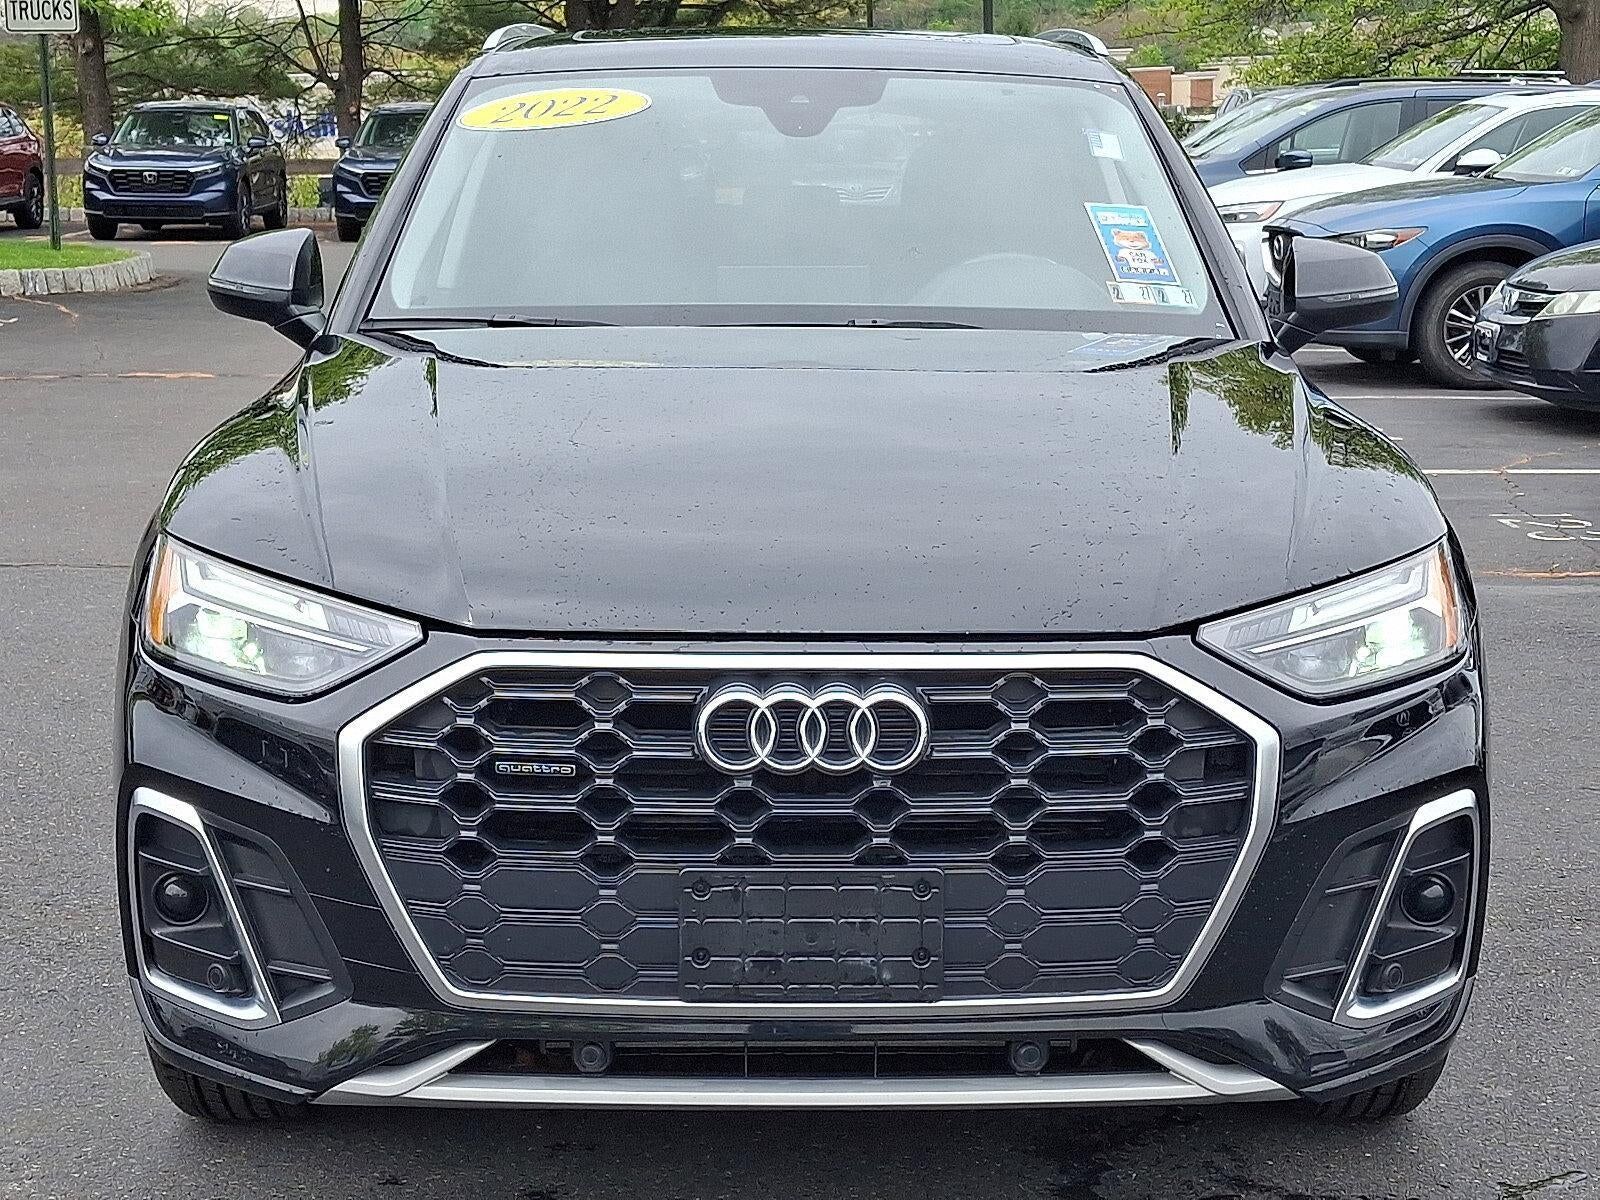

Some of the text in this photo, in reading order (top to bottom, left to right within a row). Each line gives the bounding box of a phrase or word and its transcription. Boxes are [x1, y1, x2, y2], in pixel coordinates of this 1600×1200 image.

[9, 0, 73, 20] TRUCKS
[491, 94, 618, 124] 2022
[498, 764, 572, 774] quattro
